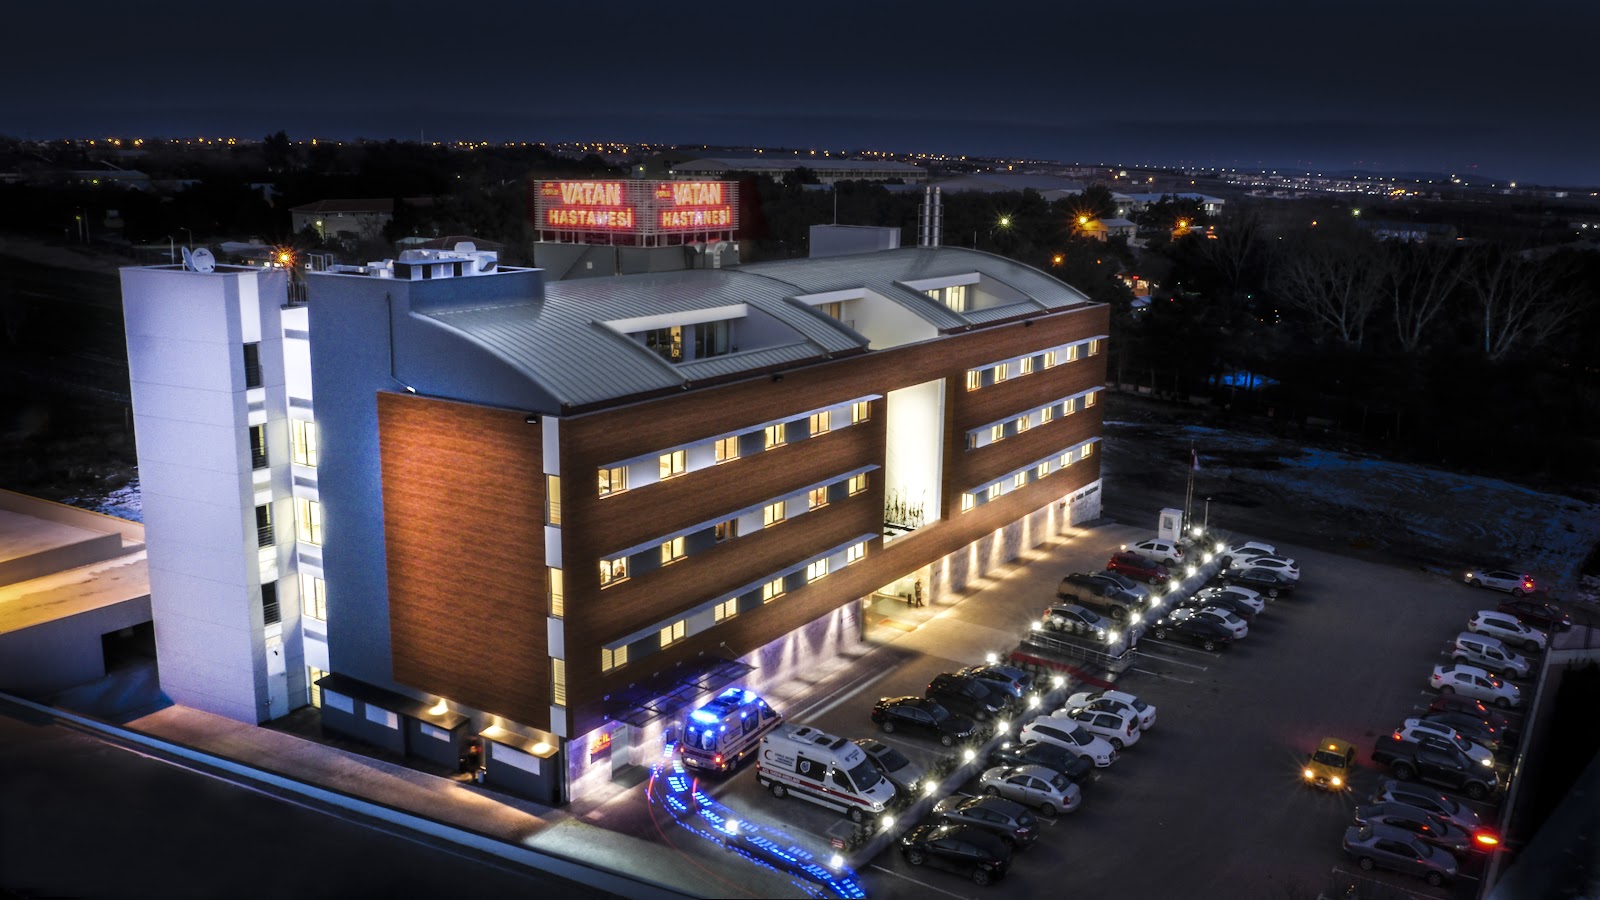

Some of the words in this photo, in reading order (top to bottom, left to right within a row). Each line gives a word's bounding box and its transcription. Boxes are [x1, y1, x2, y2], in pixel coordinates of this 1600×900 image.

[560, 182, 621, 205] VATAN
[673, 183, 721, 205] VATAN
[549, 208, 632, 227] HASTANESİ
[662, 206, 731, 227] HASTANESİ
